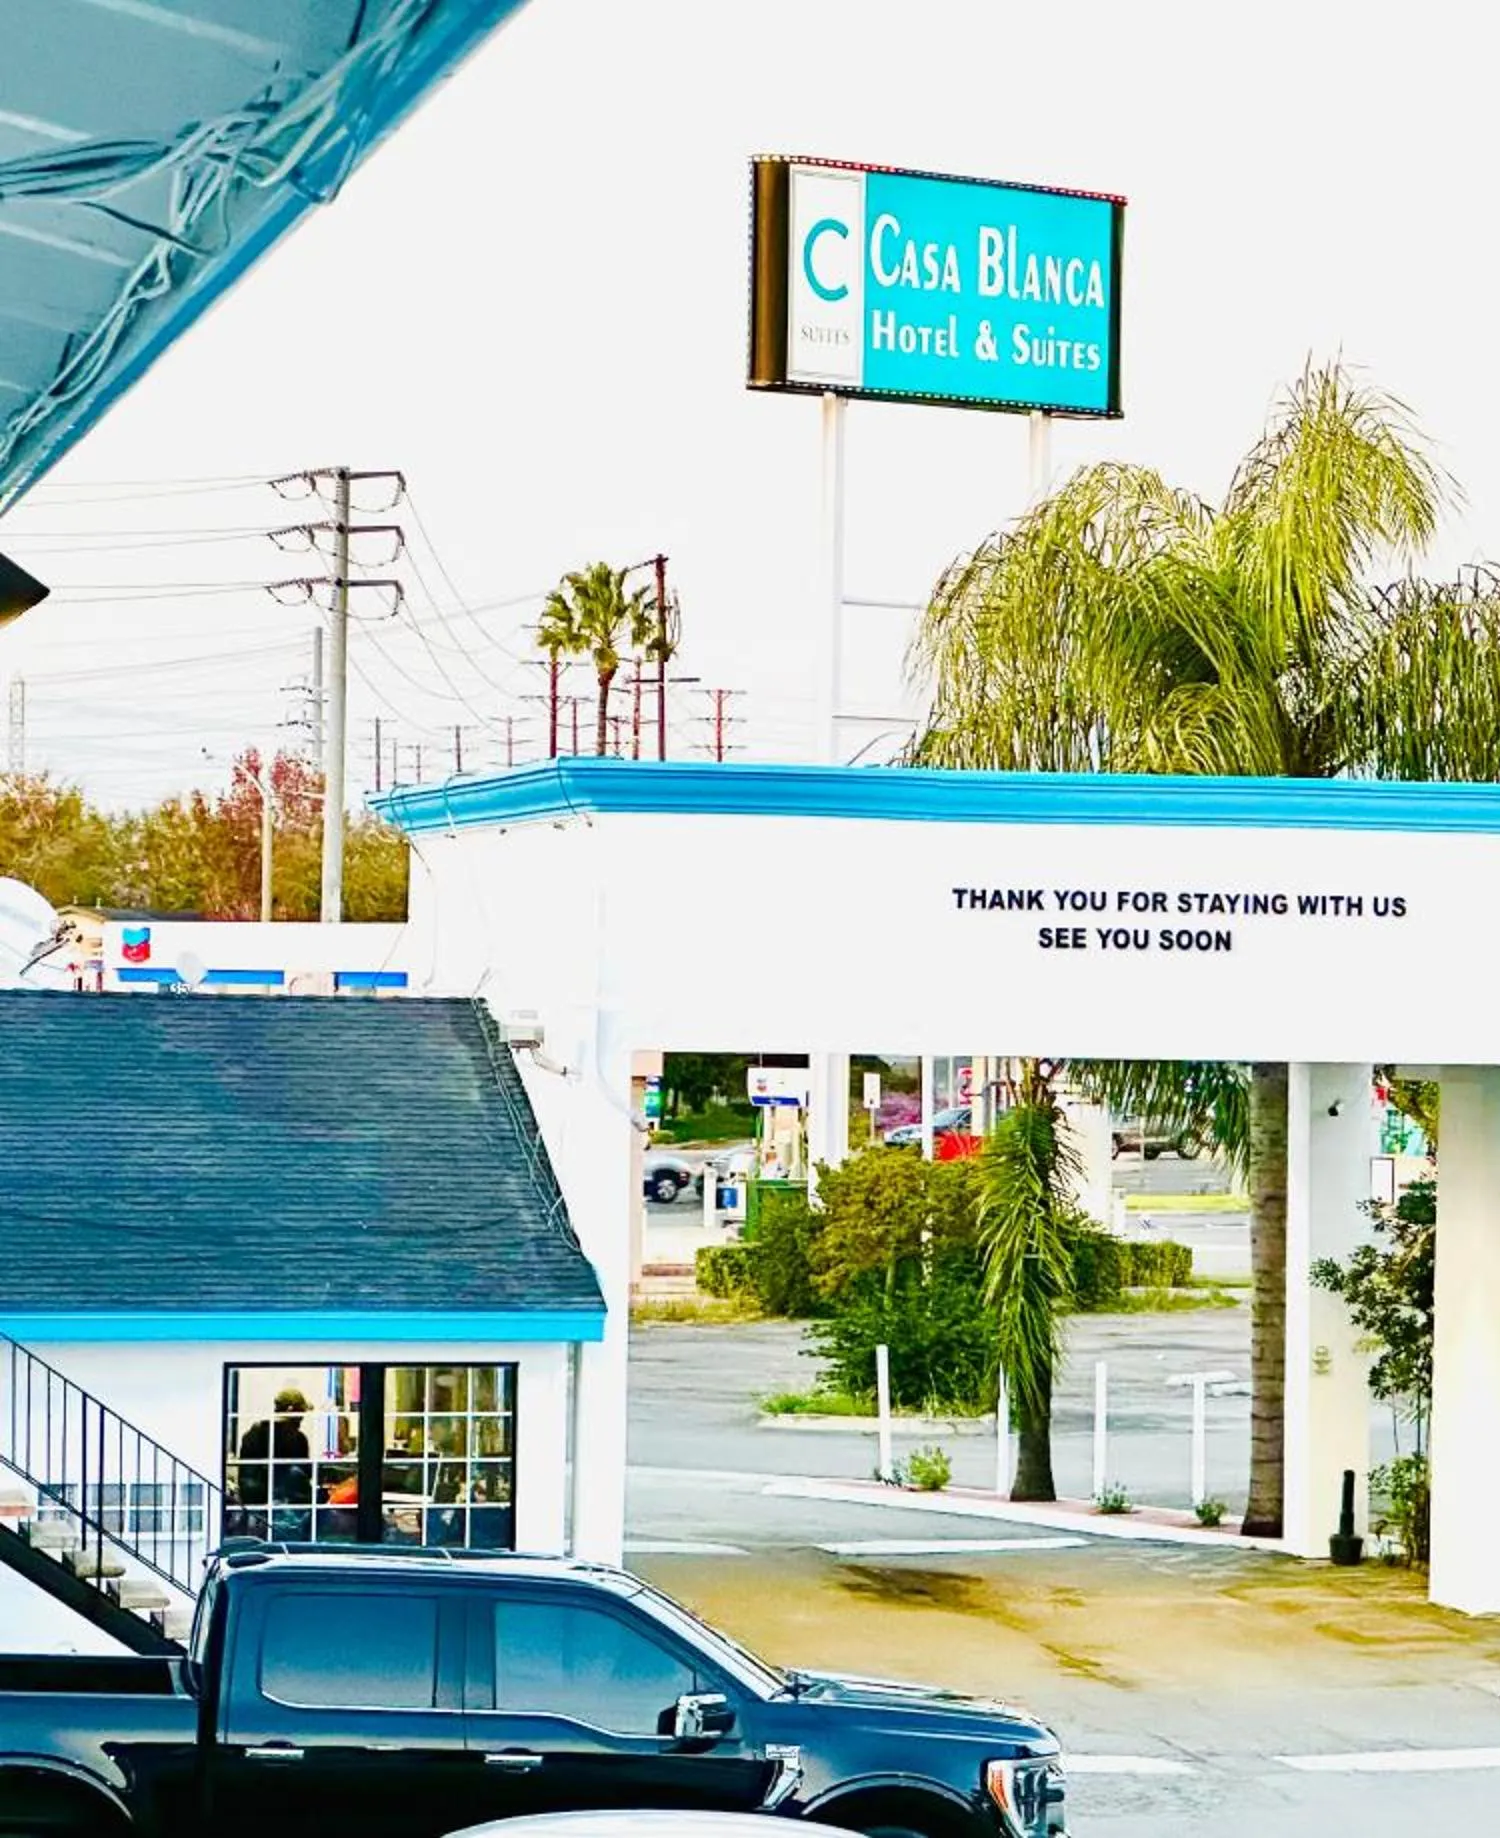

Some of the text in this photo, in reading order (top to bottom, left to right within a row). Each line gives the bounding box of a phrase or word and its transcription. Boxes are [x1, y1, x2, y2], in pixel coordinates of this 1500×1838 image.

[803, 218, 849, 301] C
[870, 213, 961, 293] CASA
[974, 319, 999, 361] &
[952, 888, 1408, 917] THANK YOU FOR STAYING WITH US
[1038, 927, 1232, 952] SEE YOU SOON
